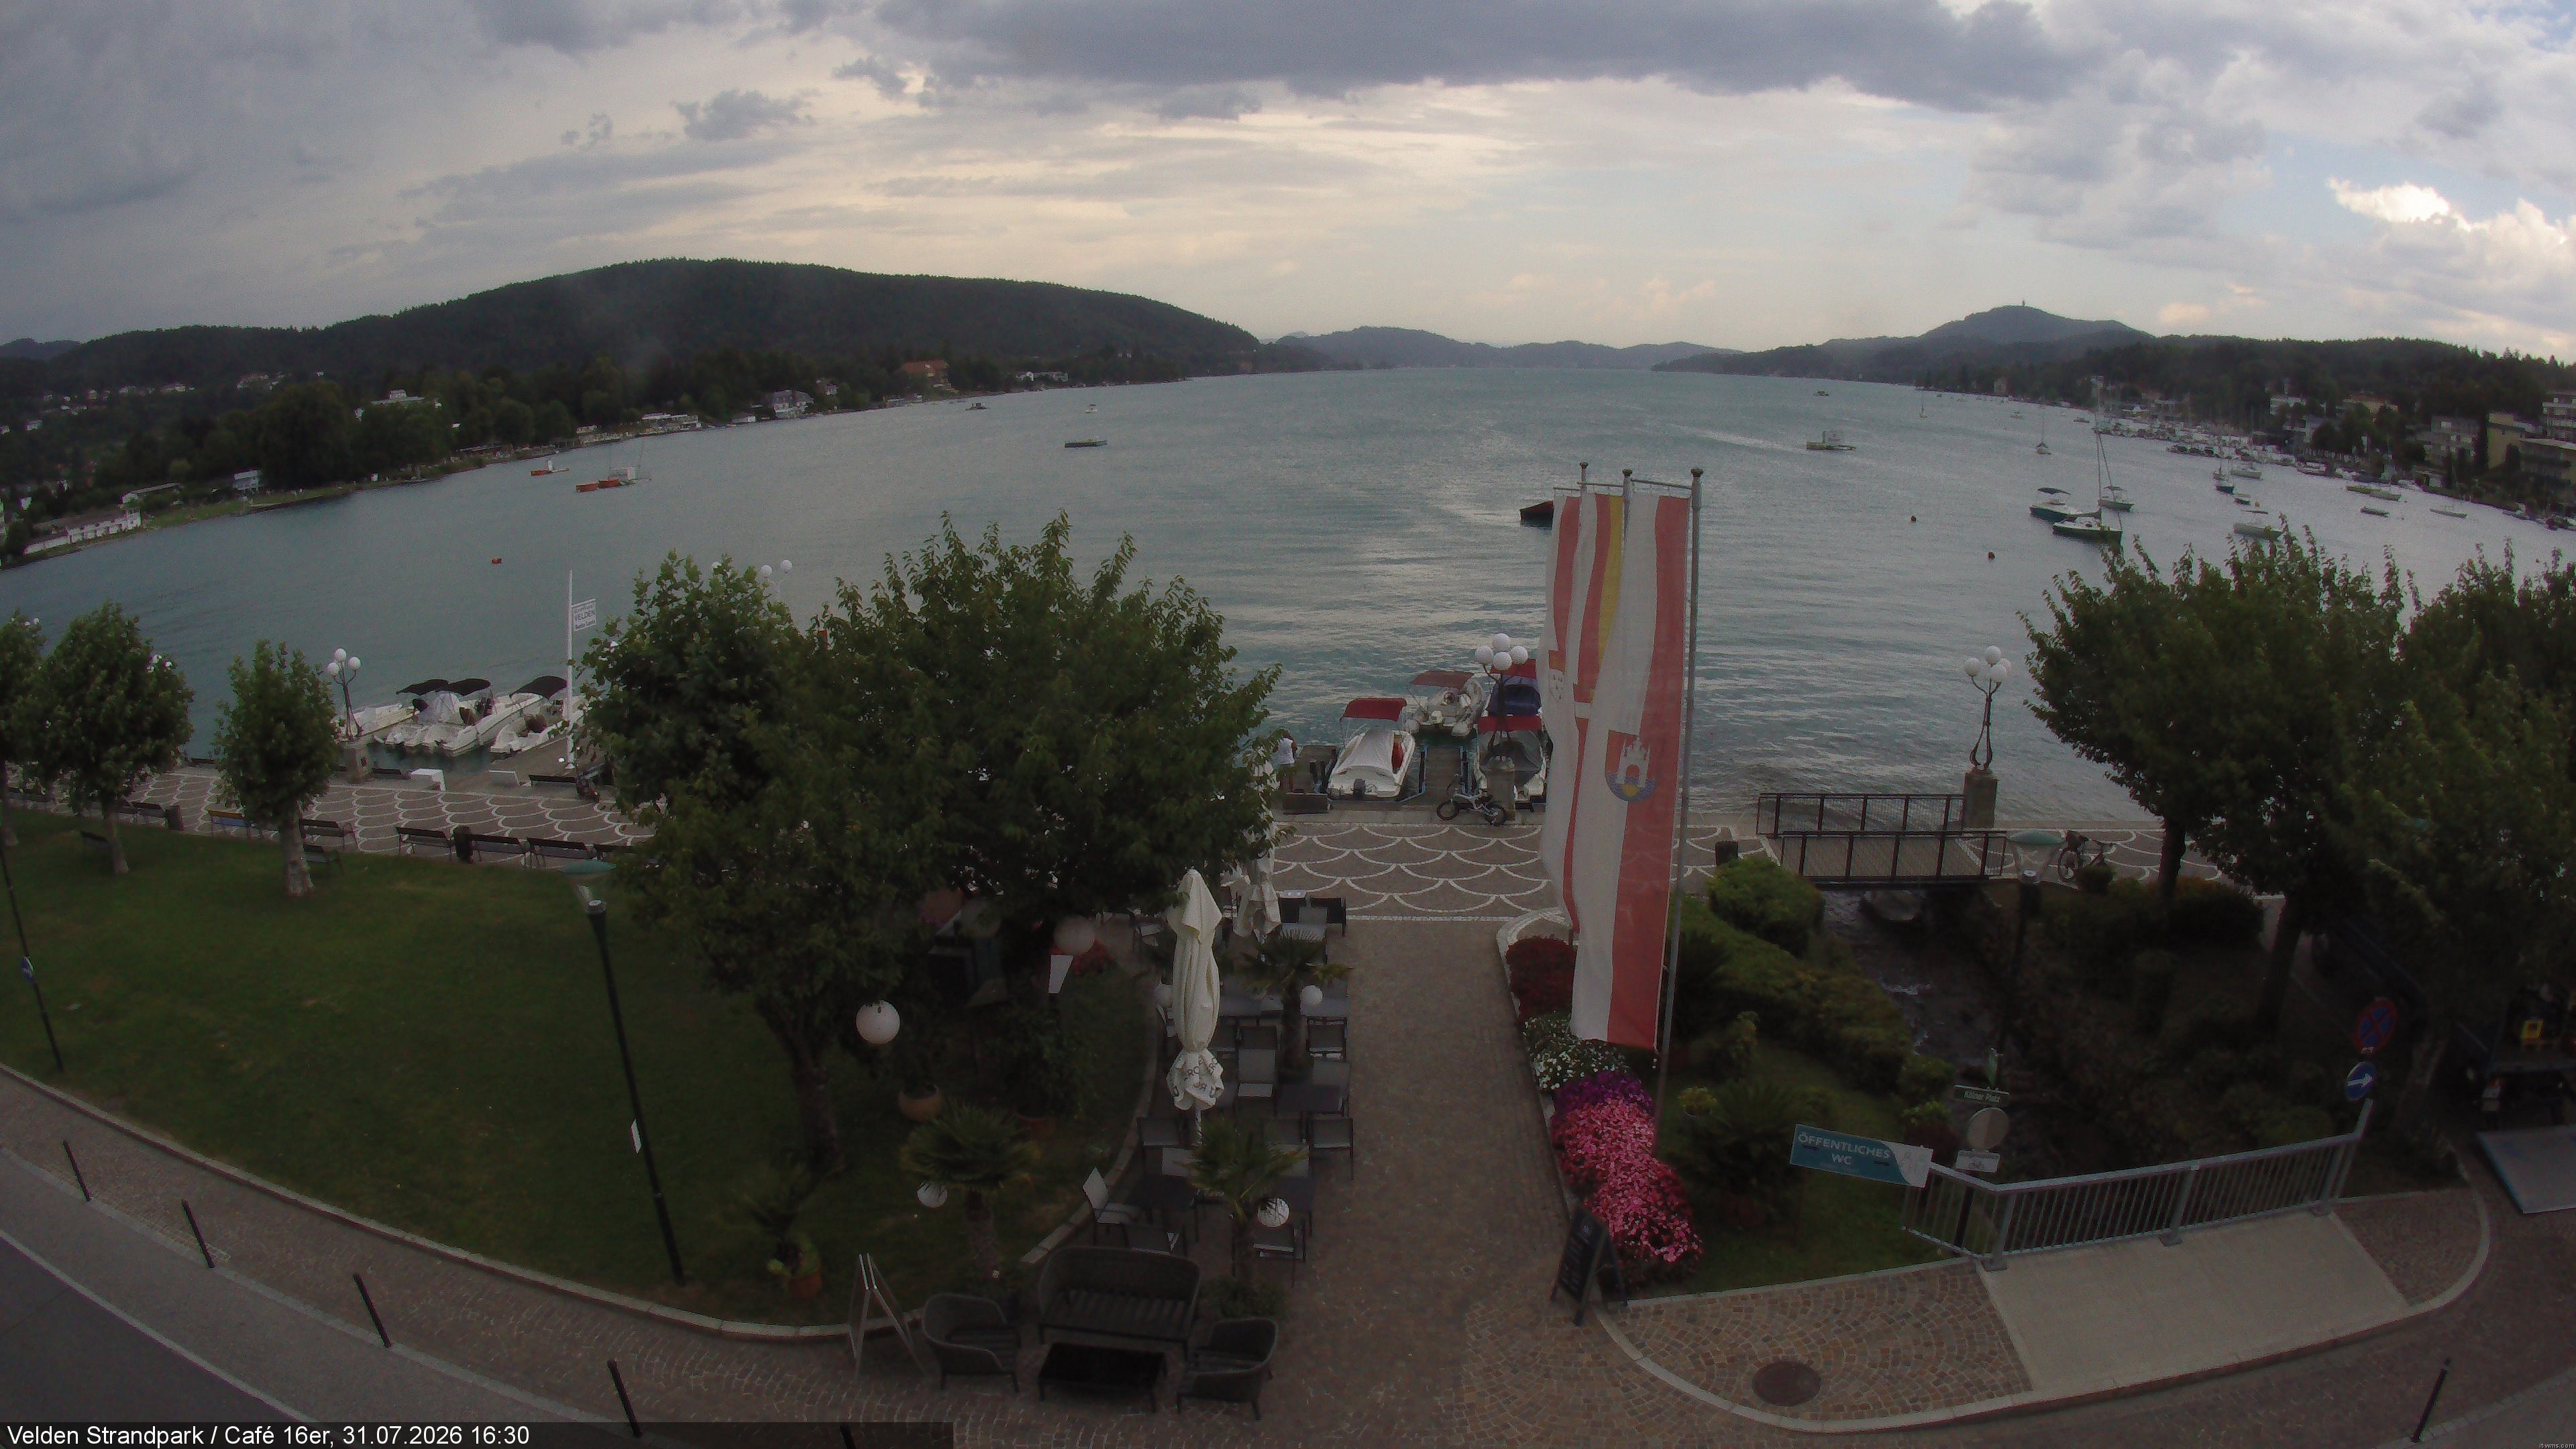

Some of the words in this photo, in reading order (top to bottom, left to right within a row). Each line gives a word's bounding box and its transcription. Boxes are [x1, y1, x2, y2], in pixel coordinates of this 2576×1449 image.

[574, 610, 595, 621] VELDEN
[1797, 1132, 1891, 1159] ÖFFENTLICHES
[1831, 1153, 1852, 1165] WC
